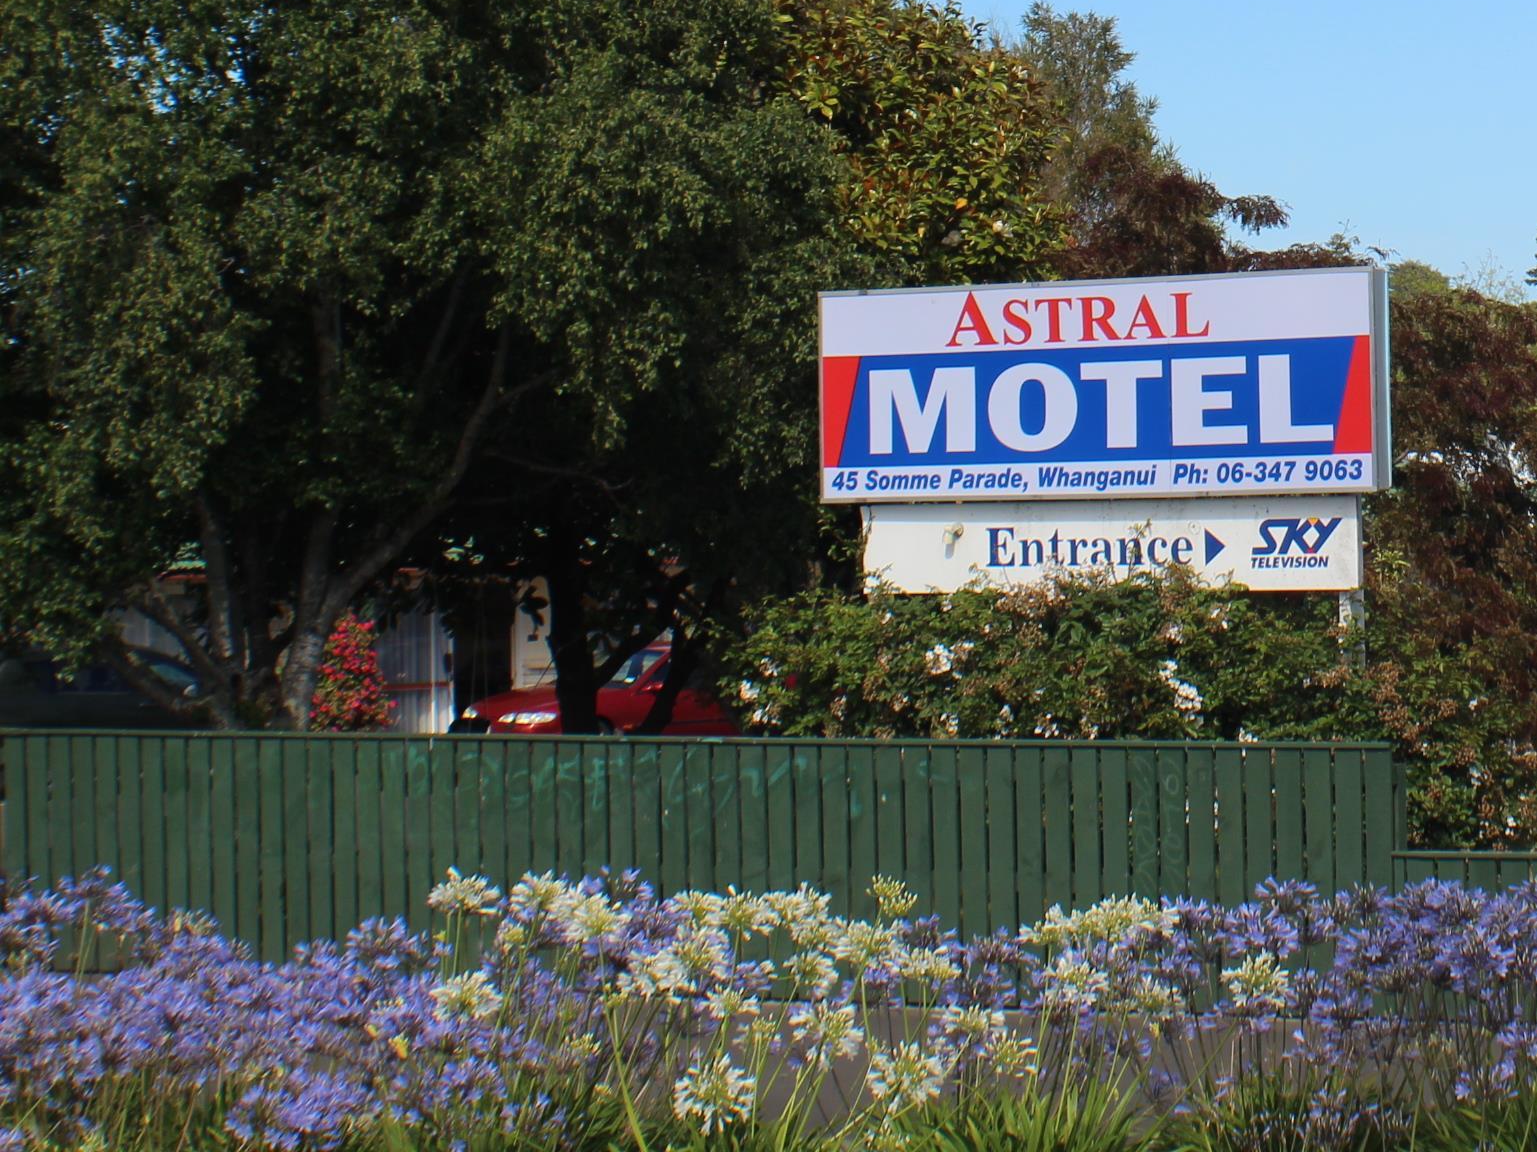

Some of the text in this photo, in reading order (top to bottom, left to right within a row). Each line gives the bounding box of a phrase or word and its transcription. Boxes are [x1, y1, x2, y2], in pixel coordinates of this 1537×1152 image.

[946, 291, 1210, 347] ASTRAL
[869, 354, 1334, 455] MOTEL
[832, 459, 1363, 492] 45 Somme Parade, Whanganui Ph: 06-347 9063
[986, 527, 1194, 567] Entrance
[1251, 517, 1343, 555] SKY
[1251, 556, 1329, 568] TELEVISION
